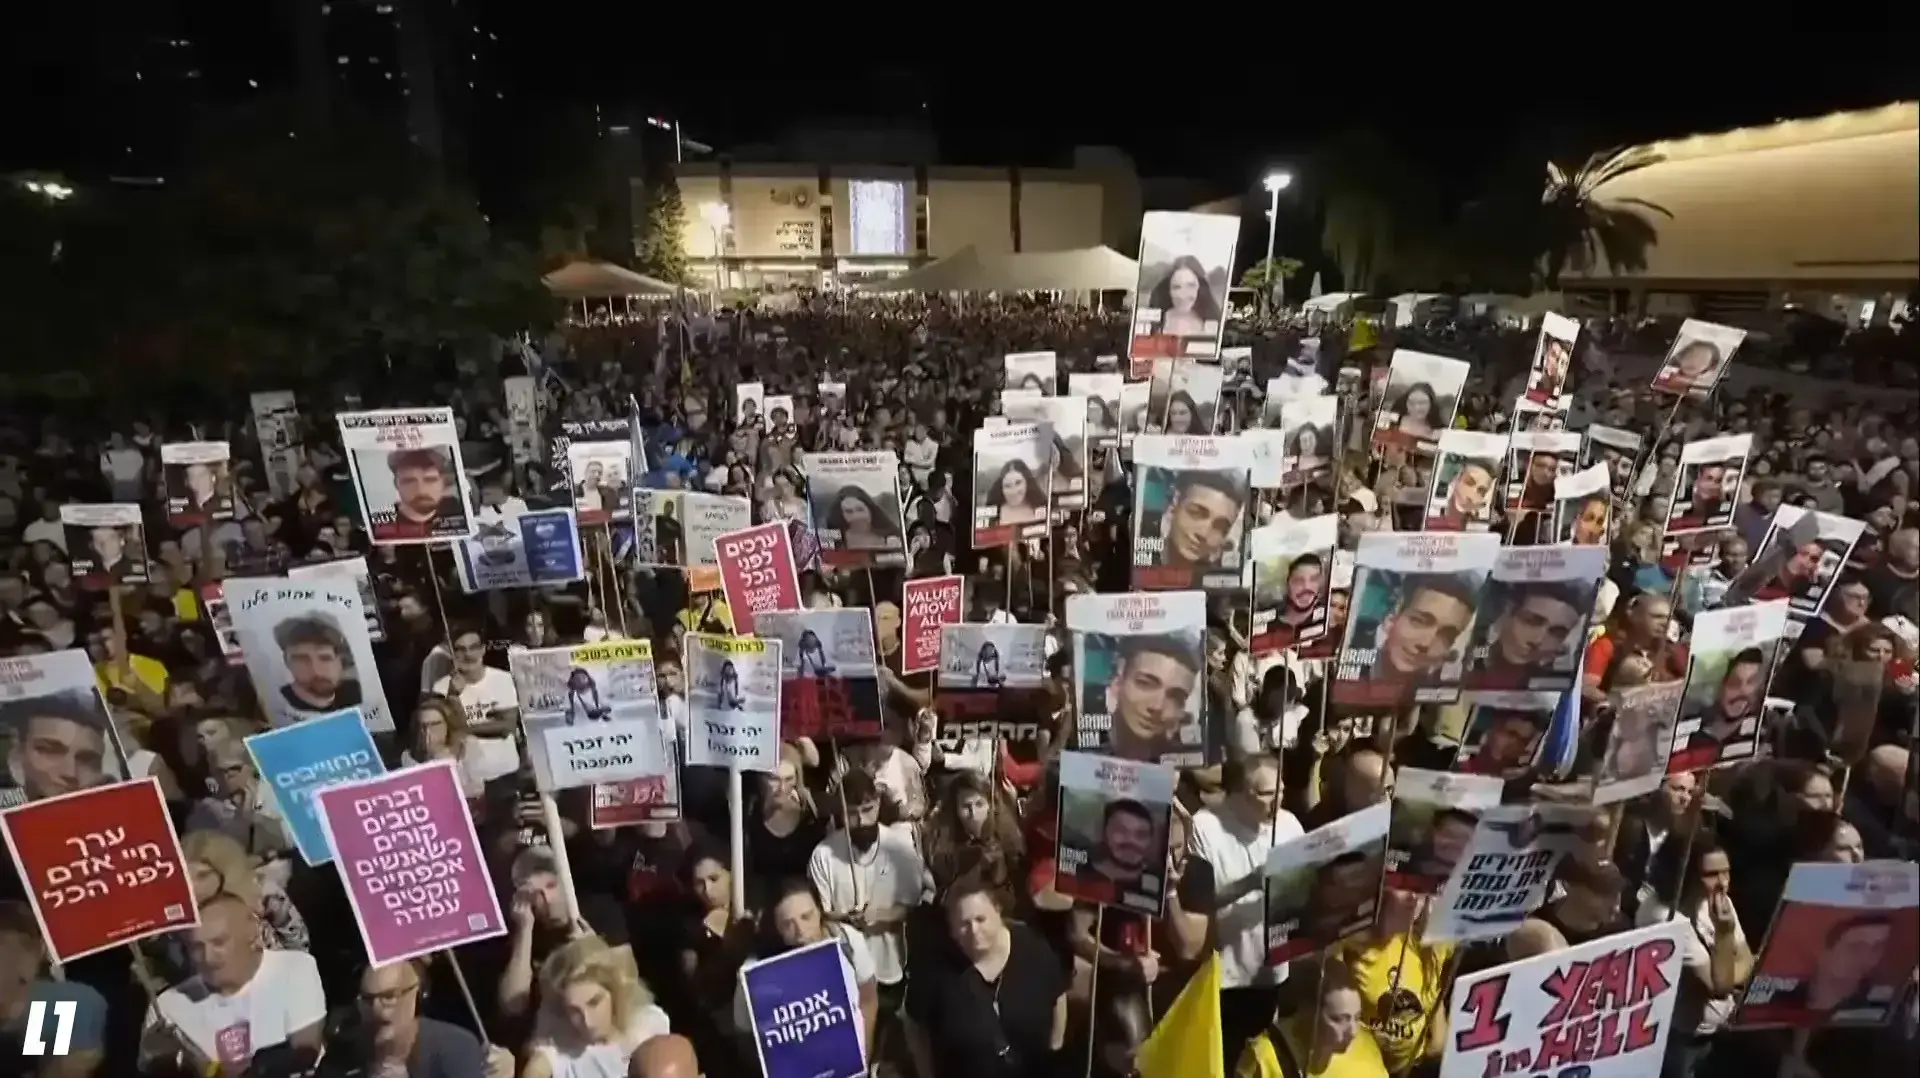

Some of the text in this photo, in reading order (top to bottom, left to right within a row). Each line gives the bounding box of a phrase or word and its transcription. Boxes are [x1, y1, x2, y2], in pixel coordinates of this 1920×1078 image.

[725, 532, 777, 558] ערכים
[738, 549, 773, 571] לפני
[740, 567, 777, 588] הכל
[908, 585, 959, 603] VALUES
[920, 616, 945, 628] ALL
[562, 732, 633, 755] יהי זכרך
[704, 721, 763, 739] יהי זכרך
[276, 749, 370, 789] מחוייבים
[570, 753, 633, 772] מהפכה!
[354, 784, 425, 817] דברים
[363, 805, 429, 834] טובים
[66, 826, 126, 858] ערך
[373, 822, 438, 854] קורים
[46, 843, 161, 884] חיי אדם
[356, 838, 462, 876] כשאנשים
[1468, 849, 1554, 872] מחזירים
[42, 859, 175, 908] לפני הכל
[366, 857, 466, 894] אכפתיים
[1515, 870, 1546, 888] את
[383, 877, 460, 909] נוקטים
[394, 898, 460, 926] עמדה
[773, 989, 831, 1024] אנחנו
[1456, 938, 1676, 1053] 1 YEAR
[765, 1005, 847, 1048] התקווה
[1529, 1002, 1660, 1074] HELL
